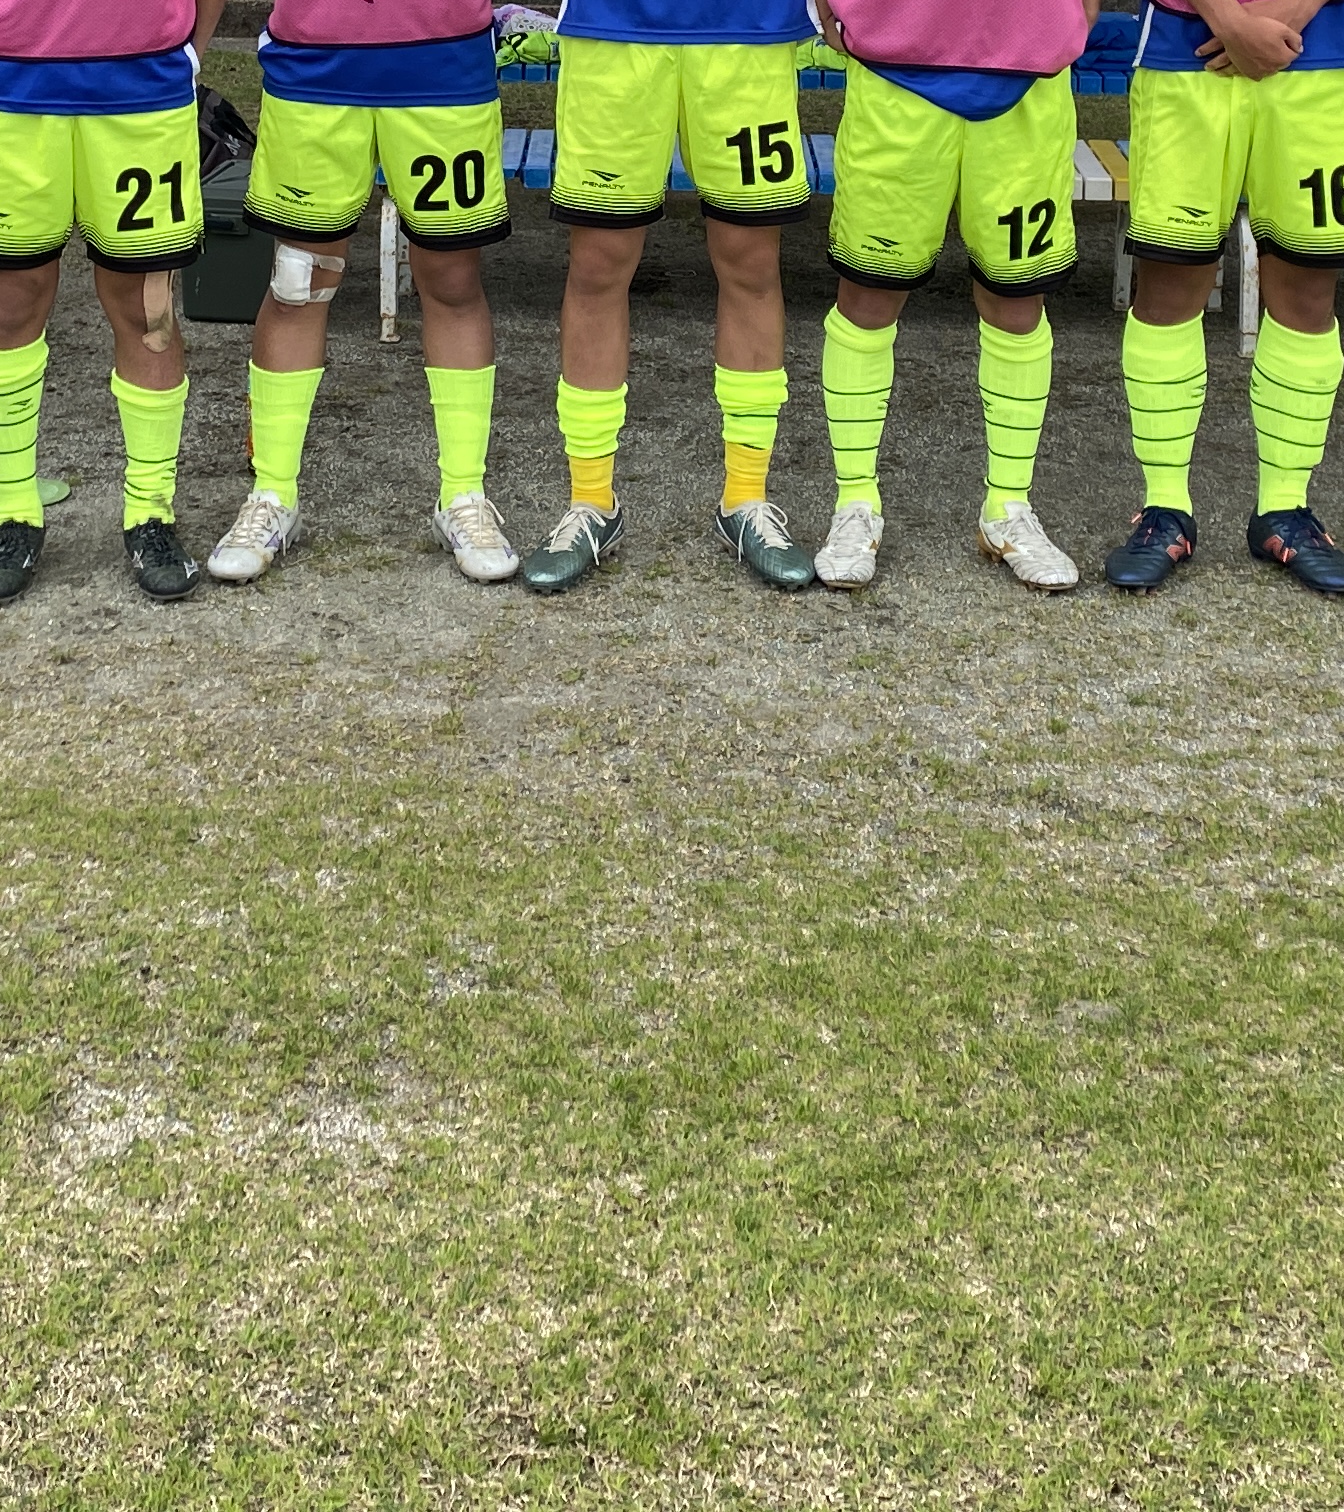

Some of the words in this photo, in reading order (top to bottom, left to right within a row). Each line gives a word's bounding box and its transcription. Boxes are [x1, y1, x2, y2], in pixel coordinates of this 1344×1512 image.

[410, 149, 485, 212] 20
[725, 119, 795, 187] 15
[115, 160, 186, 233] 21
[581, 180, 626, 191] PENALTY
[860, 243, 904, 257] PENALTY
[997, 197, 1057, 262] 12
[1167, 216, 1214, 228] PENALTY
